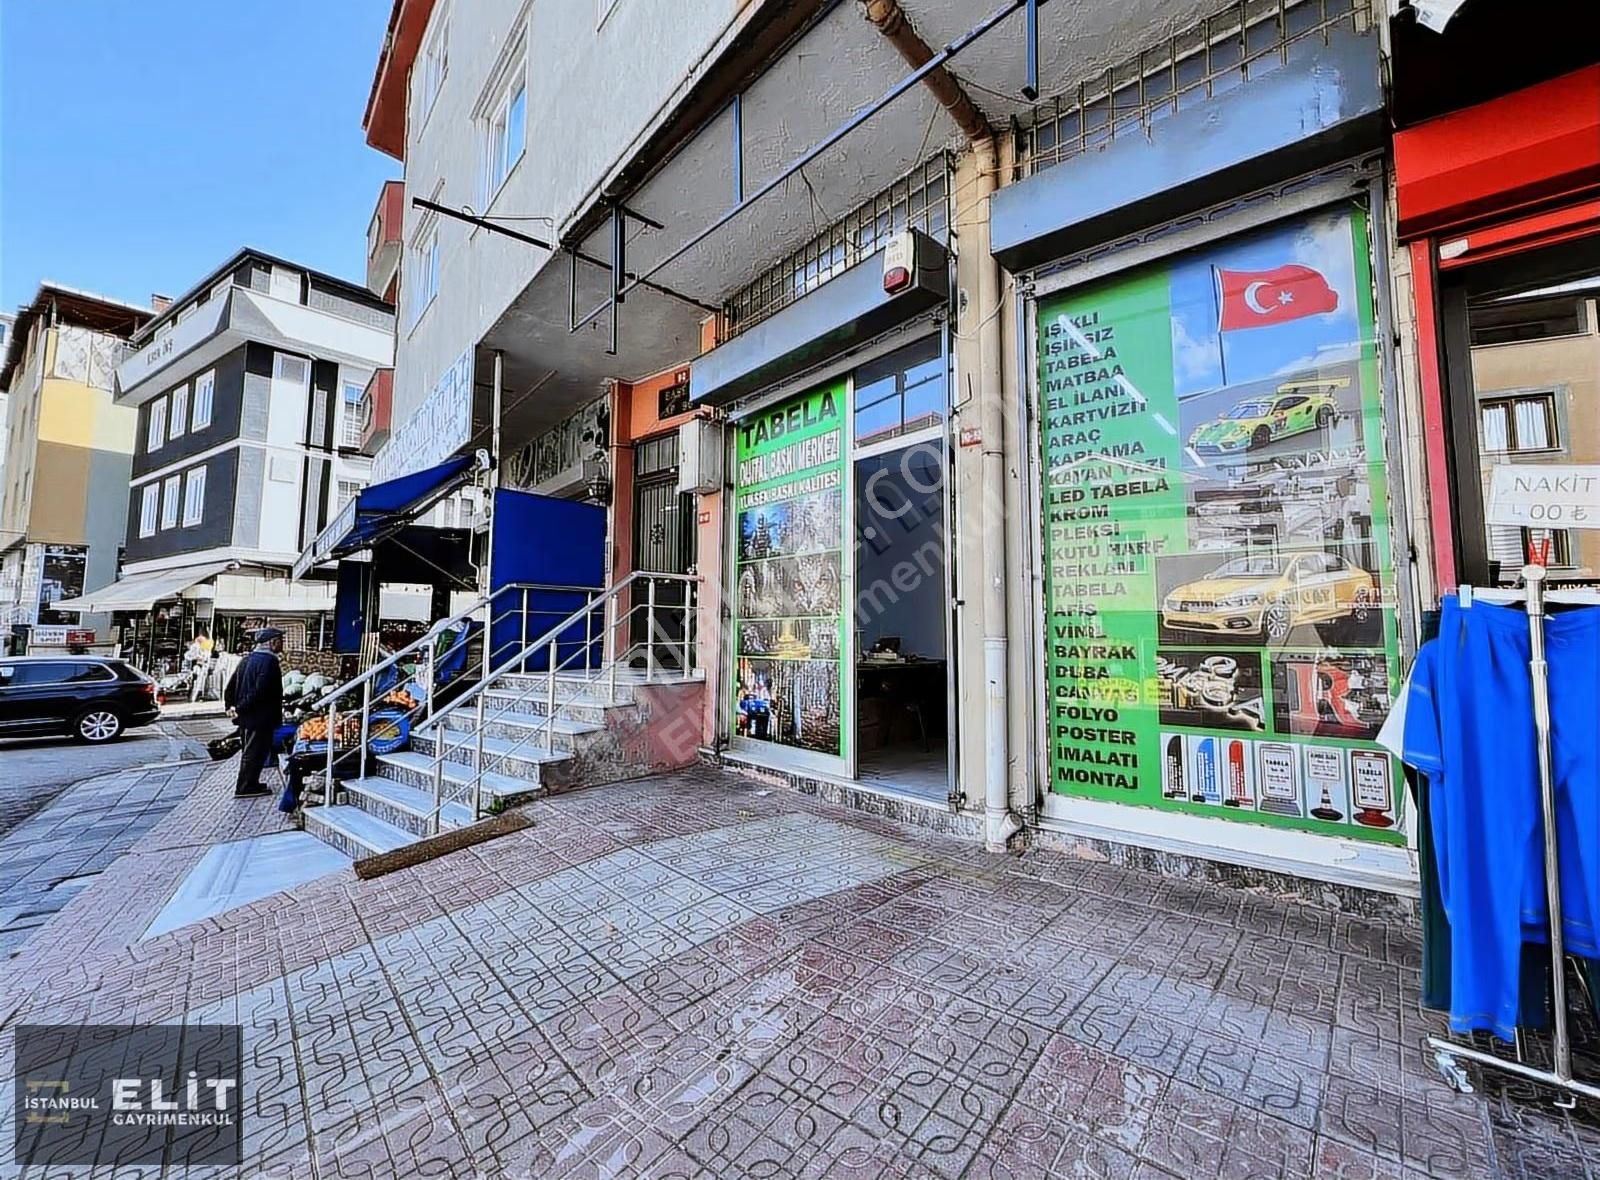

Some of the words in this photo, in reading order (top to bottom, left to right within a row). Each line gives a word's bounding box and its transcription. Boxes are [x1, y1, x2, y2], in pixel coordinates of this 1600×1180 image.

[1044, 311, 1099, 339] IŞKLI
[1046, 346, 1117, 374] TABELA
[1046, 364, 1124, 393] MATBAA
[1047, 397, 1069, 411] EL
[1074, 389, 1125, 406] İLANI
[741, 390, 837, 450] TABELA
[1049, 429, 1102, 449] ARAÇ
[1050, 489, 1085, 505] LED
[1090, 478, 1169, 499] TABELA
[1514, 473, 1597, 492] NAKİT
[1051, 504, 1109, 522] KROM
[1051, 519, 1119, 541] PLEKSİ
[1052, 545, 1100, 560] KUTU
[1054, 582, 1127, 597] TABELA
[1055, 645, 1137, 660] BAYRAK
[1056, 665, 1110, 680] DUBA
[1056, 705, 1118, 722] FOLYO
[1057, 725, 1137, 745] POSTER
[1057, 742, 1138, 769] İMALATI
[1058, 767, 1138, 790] MONTAJ
